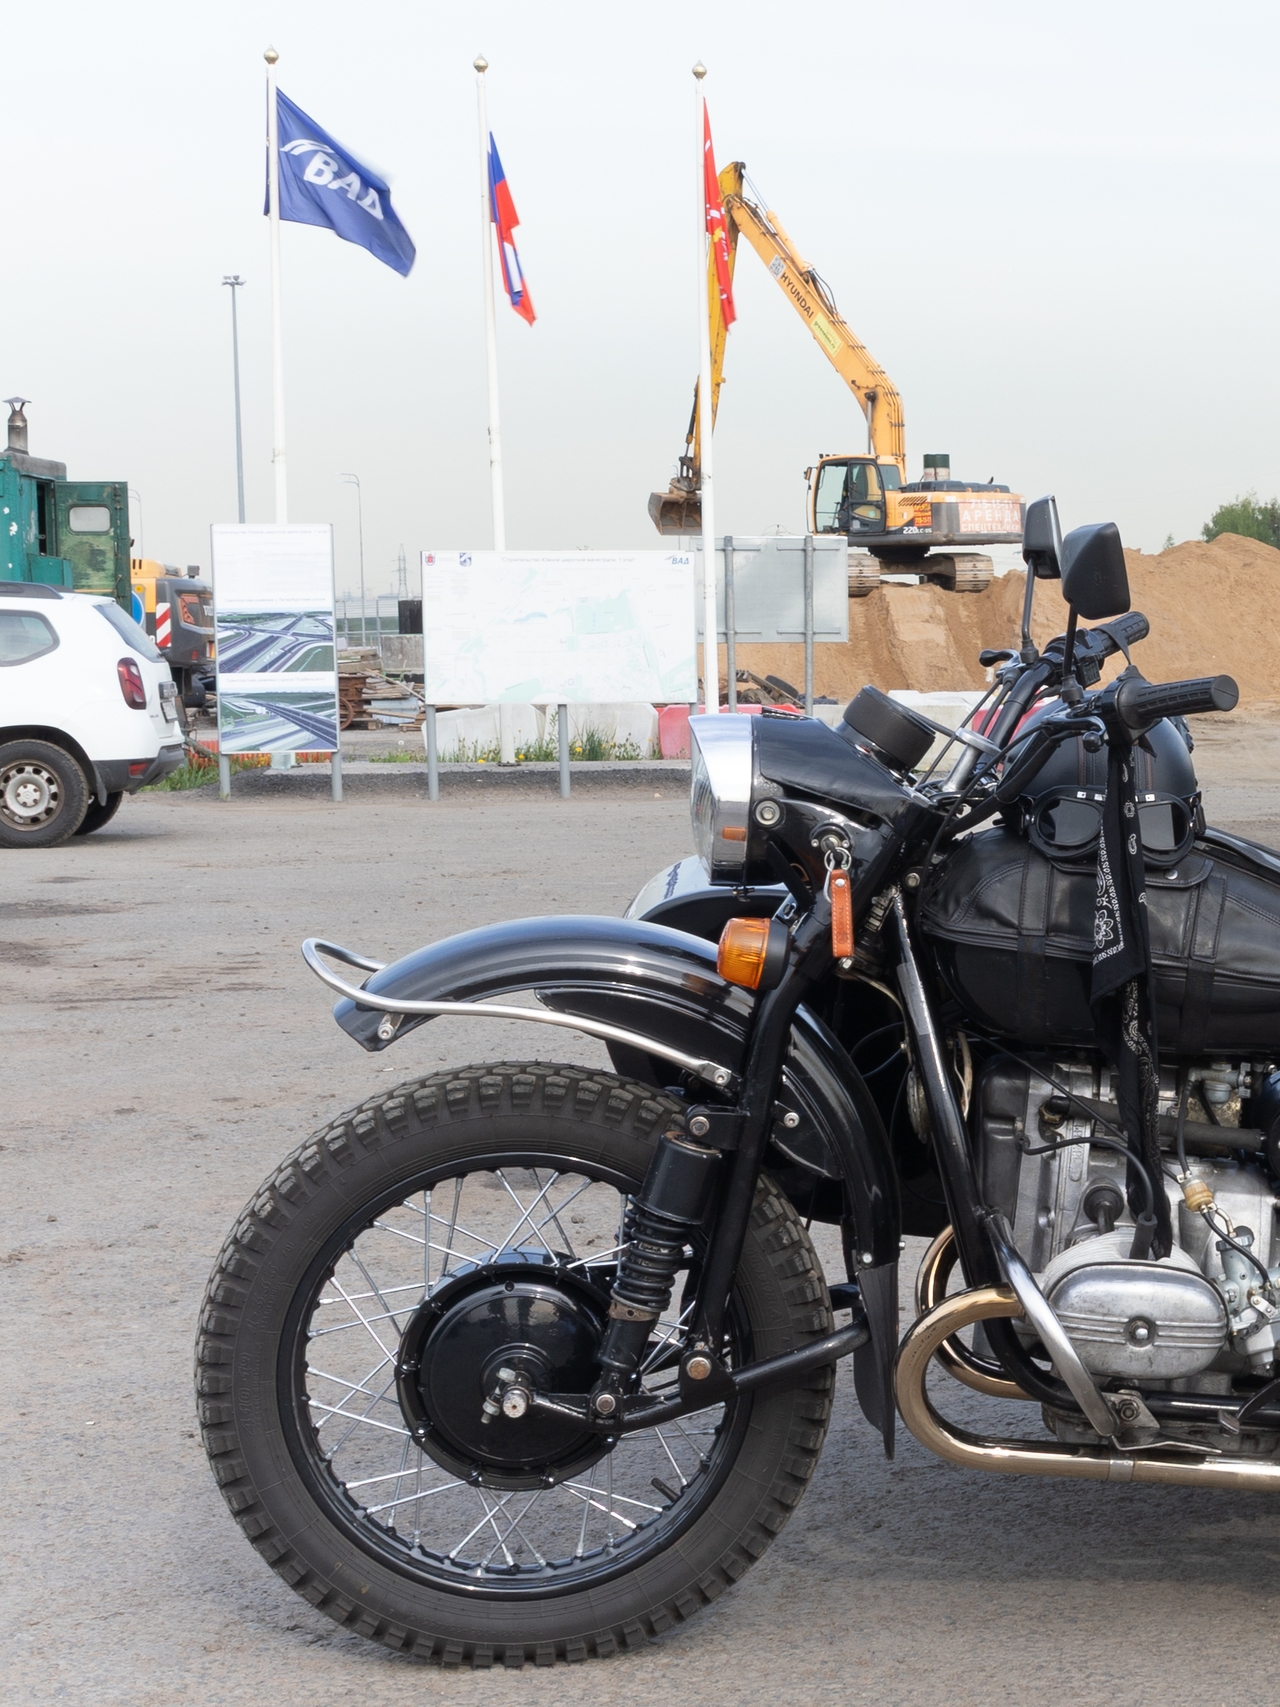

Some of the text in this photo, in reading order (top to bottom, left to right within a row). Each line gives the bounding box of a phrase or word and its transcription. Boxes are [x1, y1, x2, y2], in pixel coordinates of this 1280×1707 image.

[303, 151, 384, 220] ВАД
[781, 272, 814, 319] HYUNDAI
[962, 510, 1019, 523] АРЕНДА
[671, 557, 690, 565] ВАД
